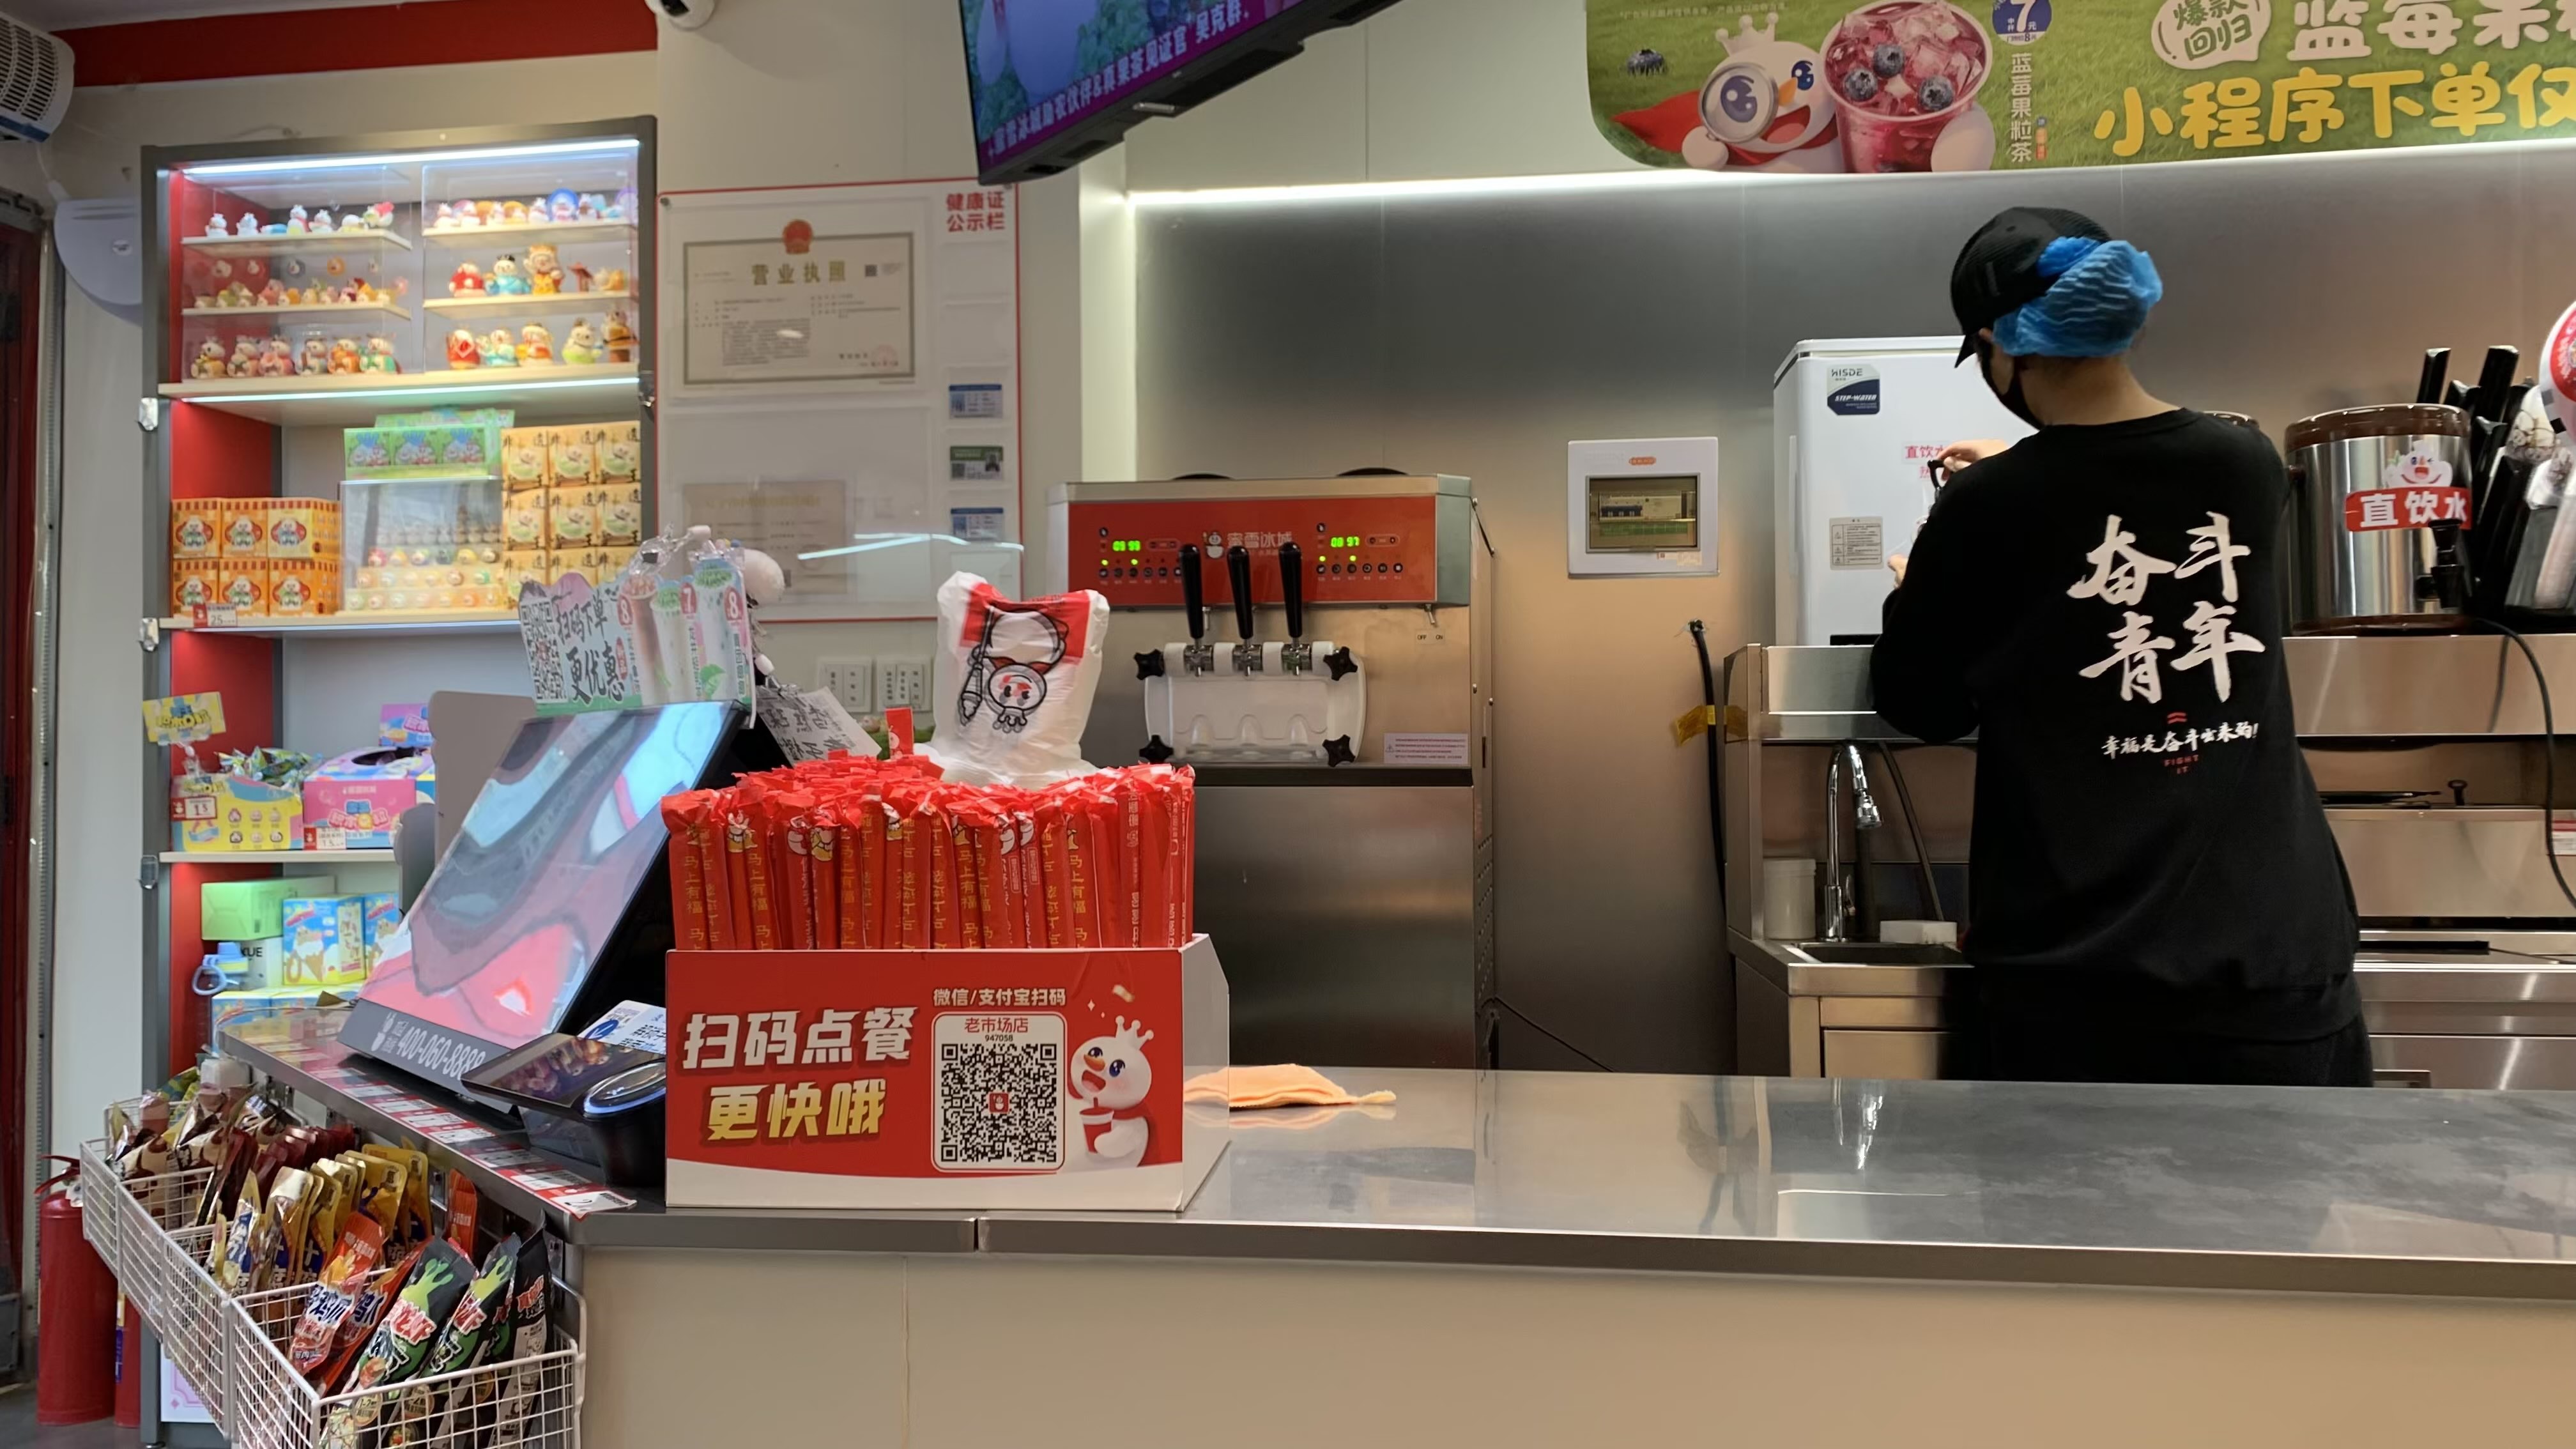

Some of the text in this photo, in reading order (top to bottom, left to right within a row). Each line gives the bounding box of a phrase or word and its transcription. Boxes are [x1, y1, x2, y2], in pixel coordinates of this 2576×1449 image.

[2184, 14, 2252, 61] 回归
[2011, 53, 2032, 162] 蓝莓果粒茶
[2094, 62, 2576, 156] 小程序下单仅
[947, 191, 1004, 211] 健康证
[947, 213, 1005, 232] 公示栏
[752, 261, 846, 286] 营业执照
[2359, 491, 2467, 528] 直饮水
[2066, 511, 2251, 606] 奋斗
[728, 591, 739, 619] 8
[565, 641, 625, 704] 更优惠
[2079, 601, 2266, 703] 青年
[960, 850, 977, 909] 马上有福
[933, 988, 1066, 1008] 微信/支付宝扫码
[682, 1006, 919, 1070] 扫码点餐
[964, 1017, 1029, 1034] 老市场店
[984, 1034, 1014, 1043] 947058
[707, 1078, 887, 1141] 更快哦
